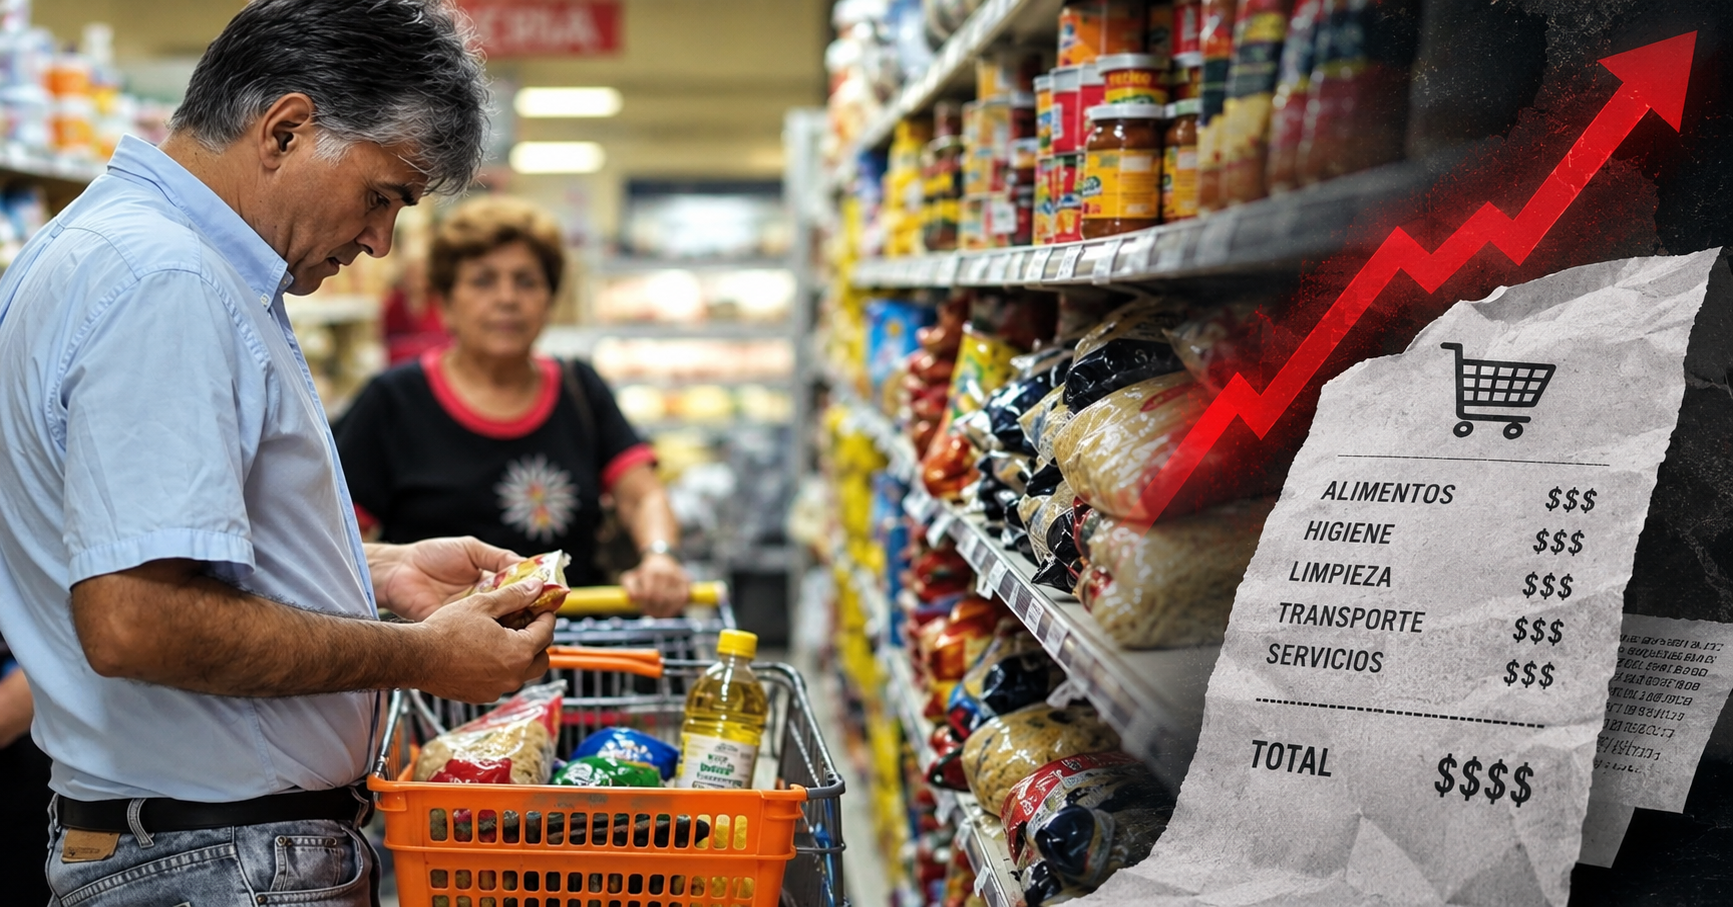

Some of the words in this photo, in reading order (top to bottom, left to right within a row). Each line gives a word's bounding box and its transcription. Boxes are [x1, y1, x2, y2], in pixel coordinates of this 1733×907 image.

[1321, 481, 1456, 505] ALIMENTOS
[1546, 486, 1598, 514] $$$
[1304, 521, 1395, 545] HIGIENE
[1533, 528, 1585, 557] $$$
[1289, 561, 1391, 588] LIMPIEZA
[1523, 572, 1574, 601] $$$
[1279, 602, 1426, 633] TRANSPORTE
[1513, 616, 1565, 647] $$$
[1266, 643, 1384, 673] SERVICIOS
[1503, 659, 1556, 690] $$$
[1251, 740, 1332, 778] TOTAL
[1434, 753, 1534, 808] $$$$
